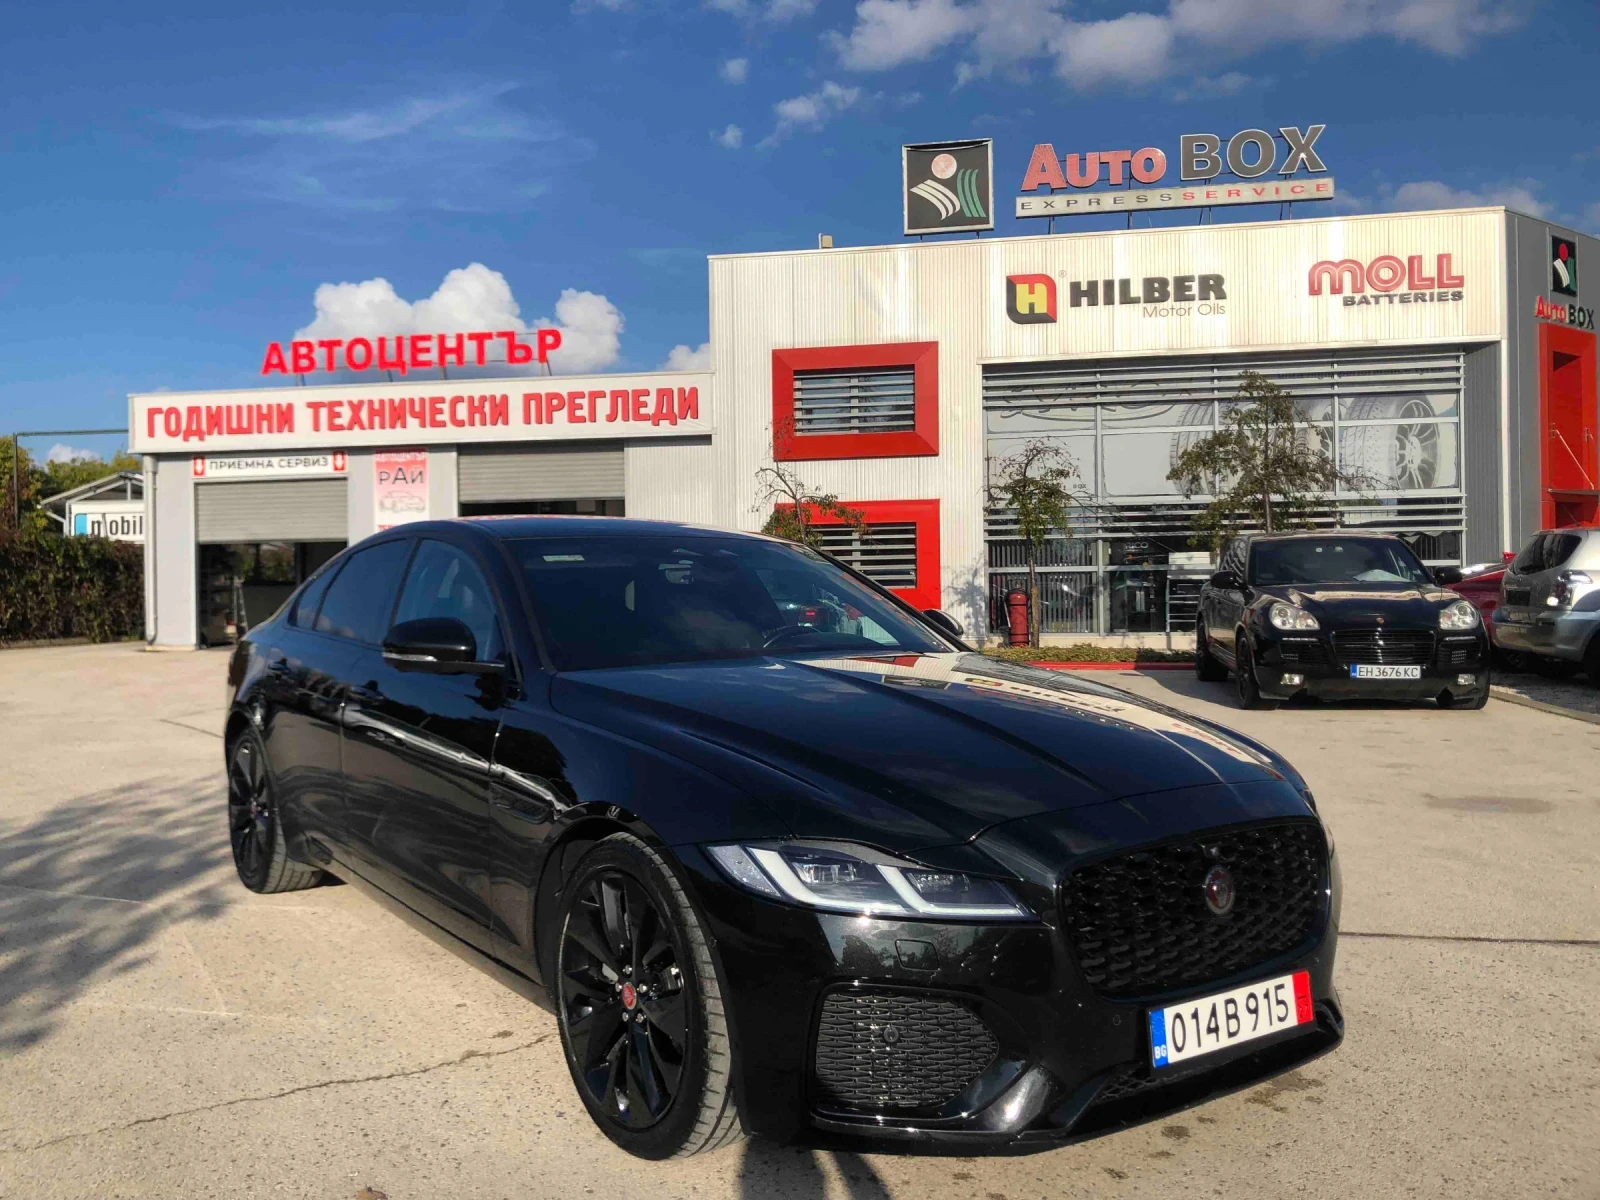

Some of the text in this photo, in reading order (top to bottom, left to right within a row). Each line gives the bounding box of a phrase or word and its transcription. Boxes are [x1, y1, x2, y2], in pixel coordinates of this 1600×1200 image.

[1180, 123, 1328, 182] BOX
[1069, 273, 1228, 308] HILBER
[1342, 289, 1465, 307] BATTERIES
[1142, 302, 1226, 319] Motor Oils
[1567, 303, 1595, 330] BOX
[261, 328, 563, 377] АВТОЦЕНТЪР
[147, 386, 699, 442] ГОДИШНИ ТЕХНИЧЕСКИ ПРЕГЛЕДИ
[209, 456, 329, 471] ПРИЕМНА СЕРВИЗ
[1358, 666, 1419, 678] EH 3676 KC
[1154, 1044, 1168, 1060] BG
